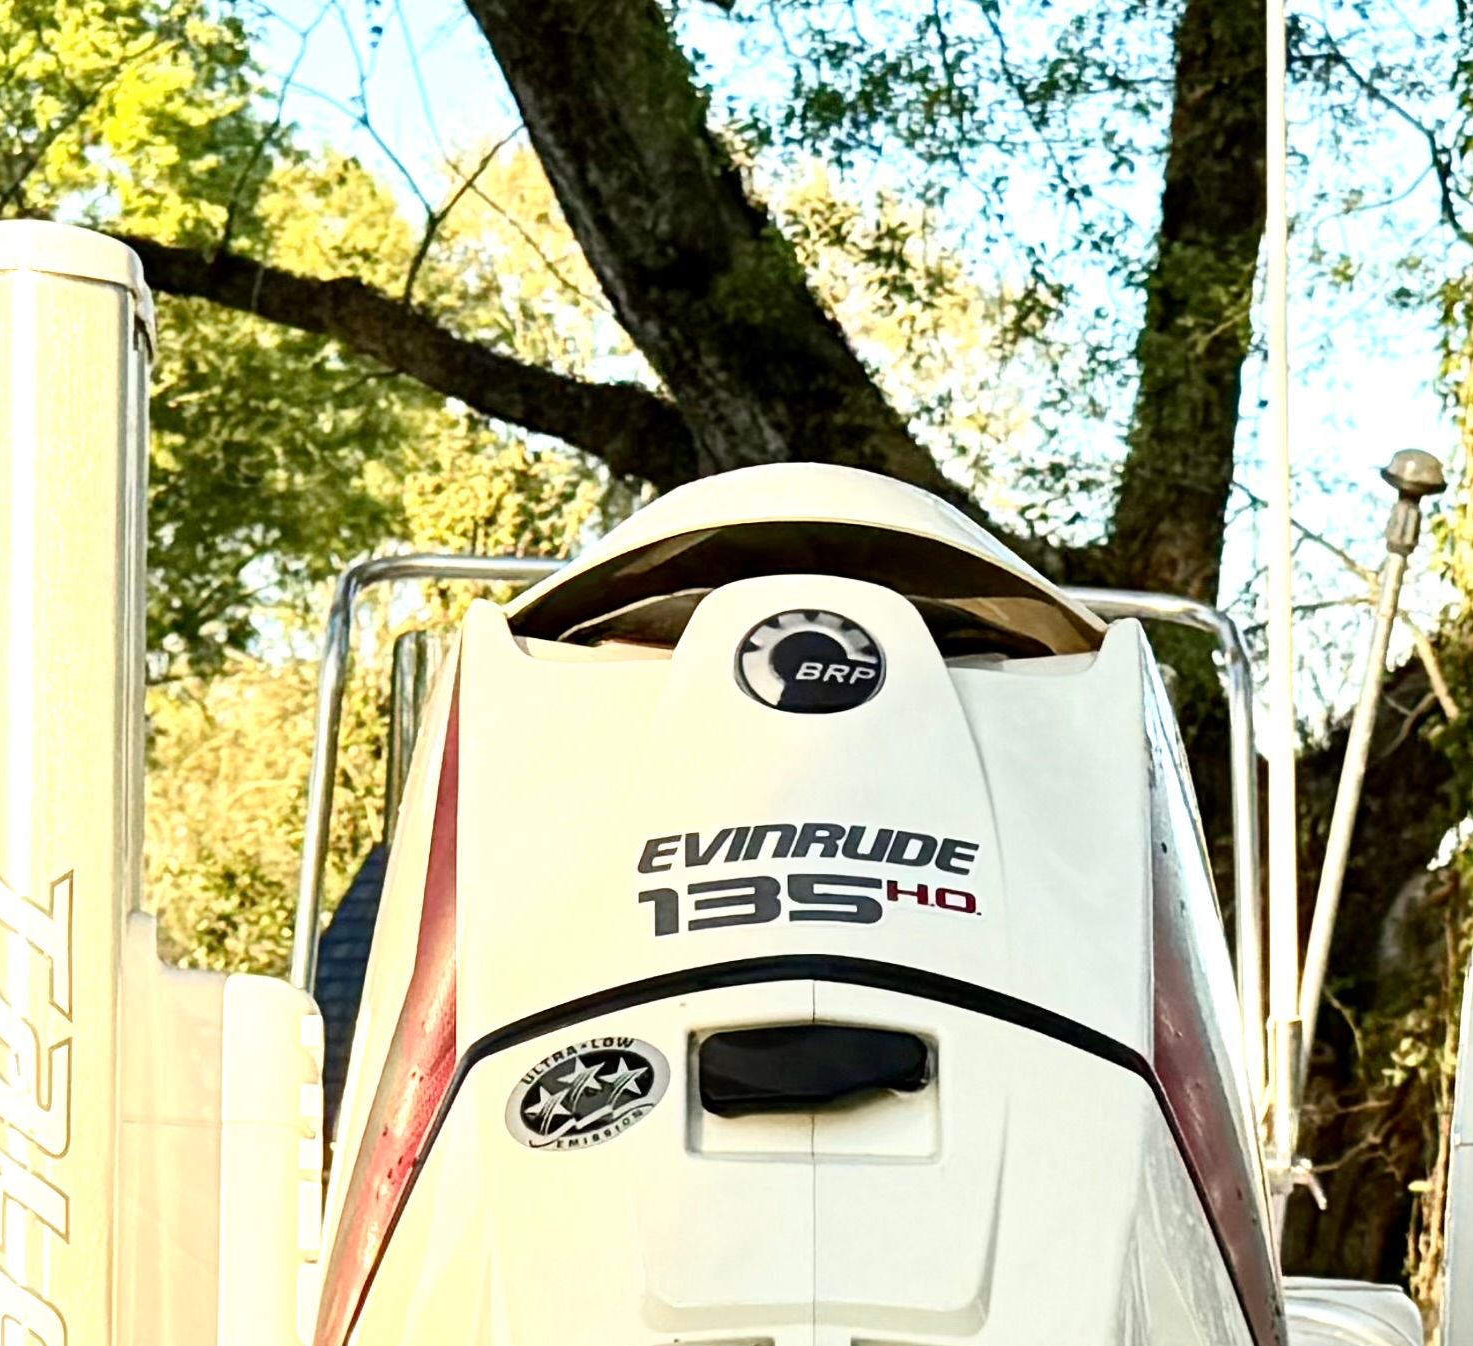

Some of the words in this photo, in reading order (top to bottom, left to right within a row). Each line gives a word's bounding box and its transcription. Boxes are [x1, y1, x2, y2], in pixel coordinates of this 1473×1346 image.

[795, 661, 877, 685] BRP
[636, 822, 980, 876] EVINRUDE
[637, 873, 884, 938] 135
[886, 879, 983, 916] H.O.
